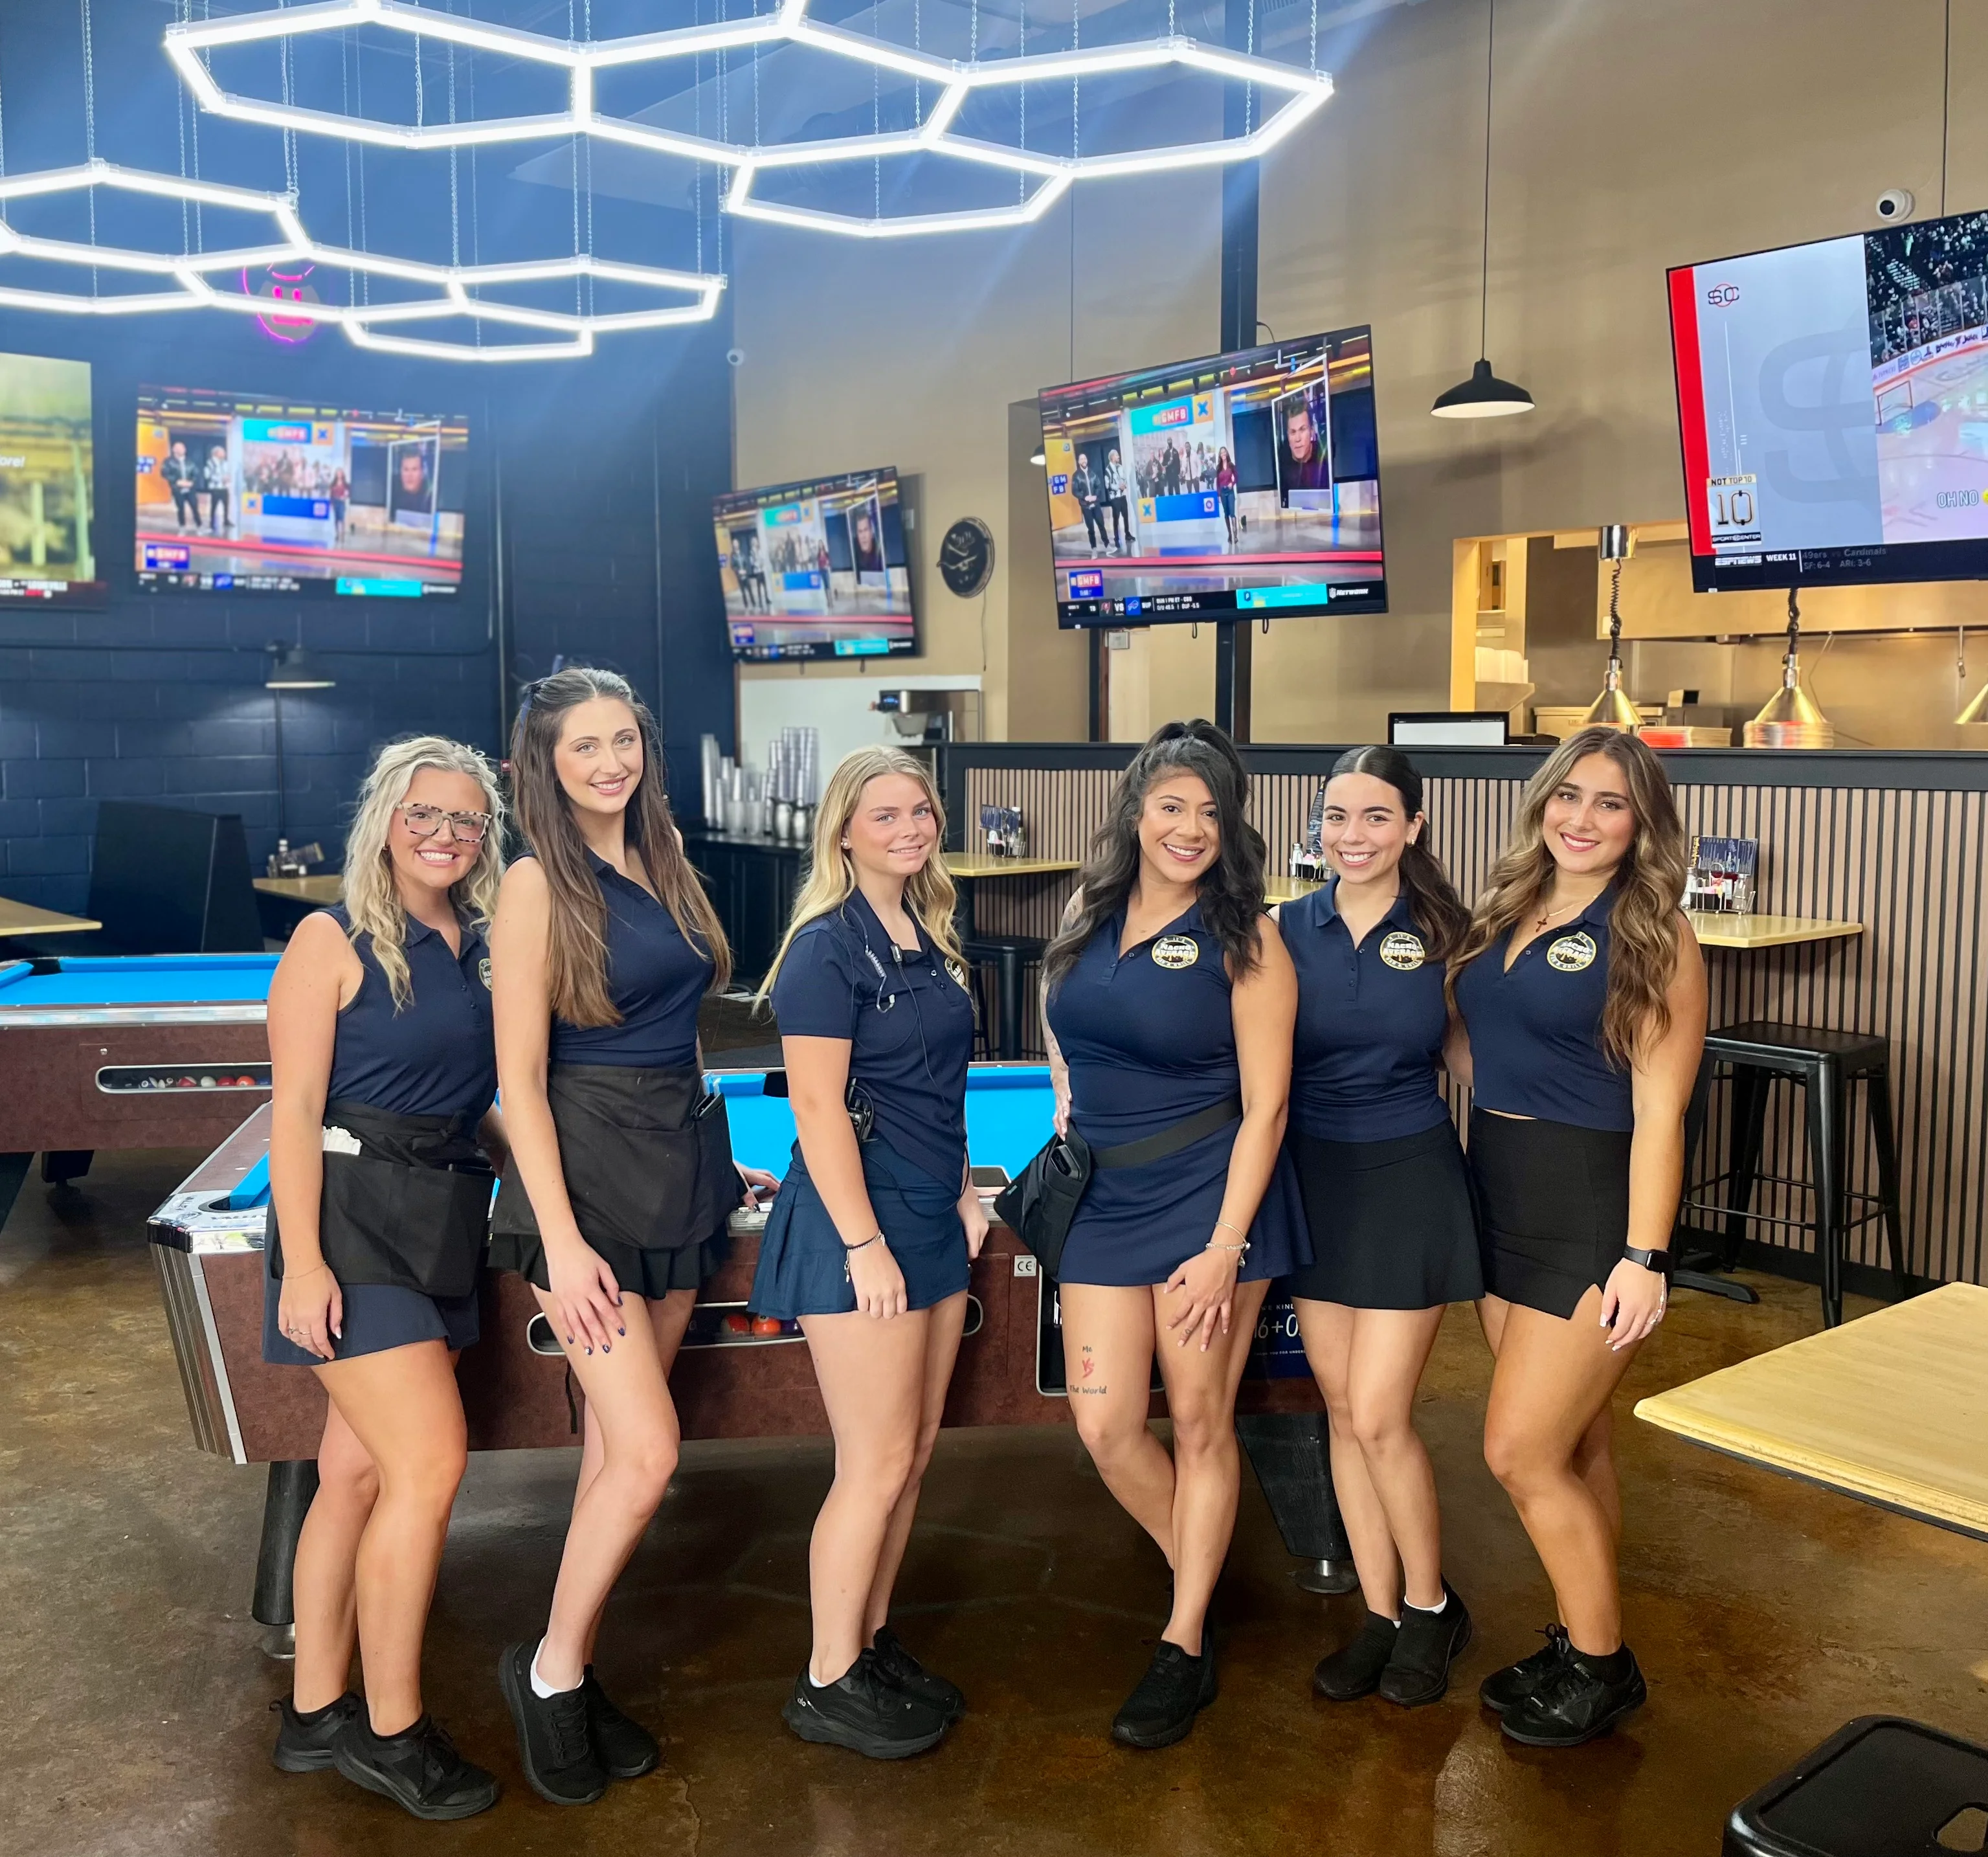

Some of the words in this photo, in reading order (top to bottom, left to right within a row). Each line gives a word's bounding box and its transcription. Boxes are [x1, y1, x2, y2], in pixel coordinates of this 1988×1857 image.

[1708, 287, 1739, 304] SC
[1161, 408, 1186, 423] GMFB
[1937, 491, 1957, 508] OH
[1959, 490, 1979, 506] NO
[1717, 491, 1752, 525] 10
[1766, 553, 1788, 562] WEEK
[1789, 552, 1797, 561] 11
[1844, 547, 1887, 557] Cardinals
[1115, 603, 1124, 612] VS
[1018, 1261, 1033, 1272] CE
